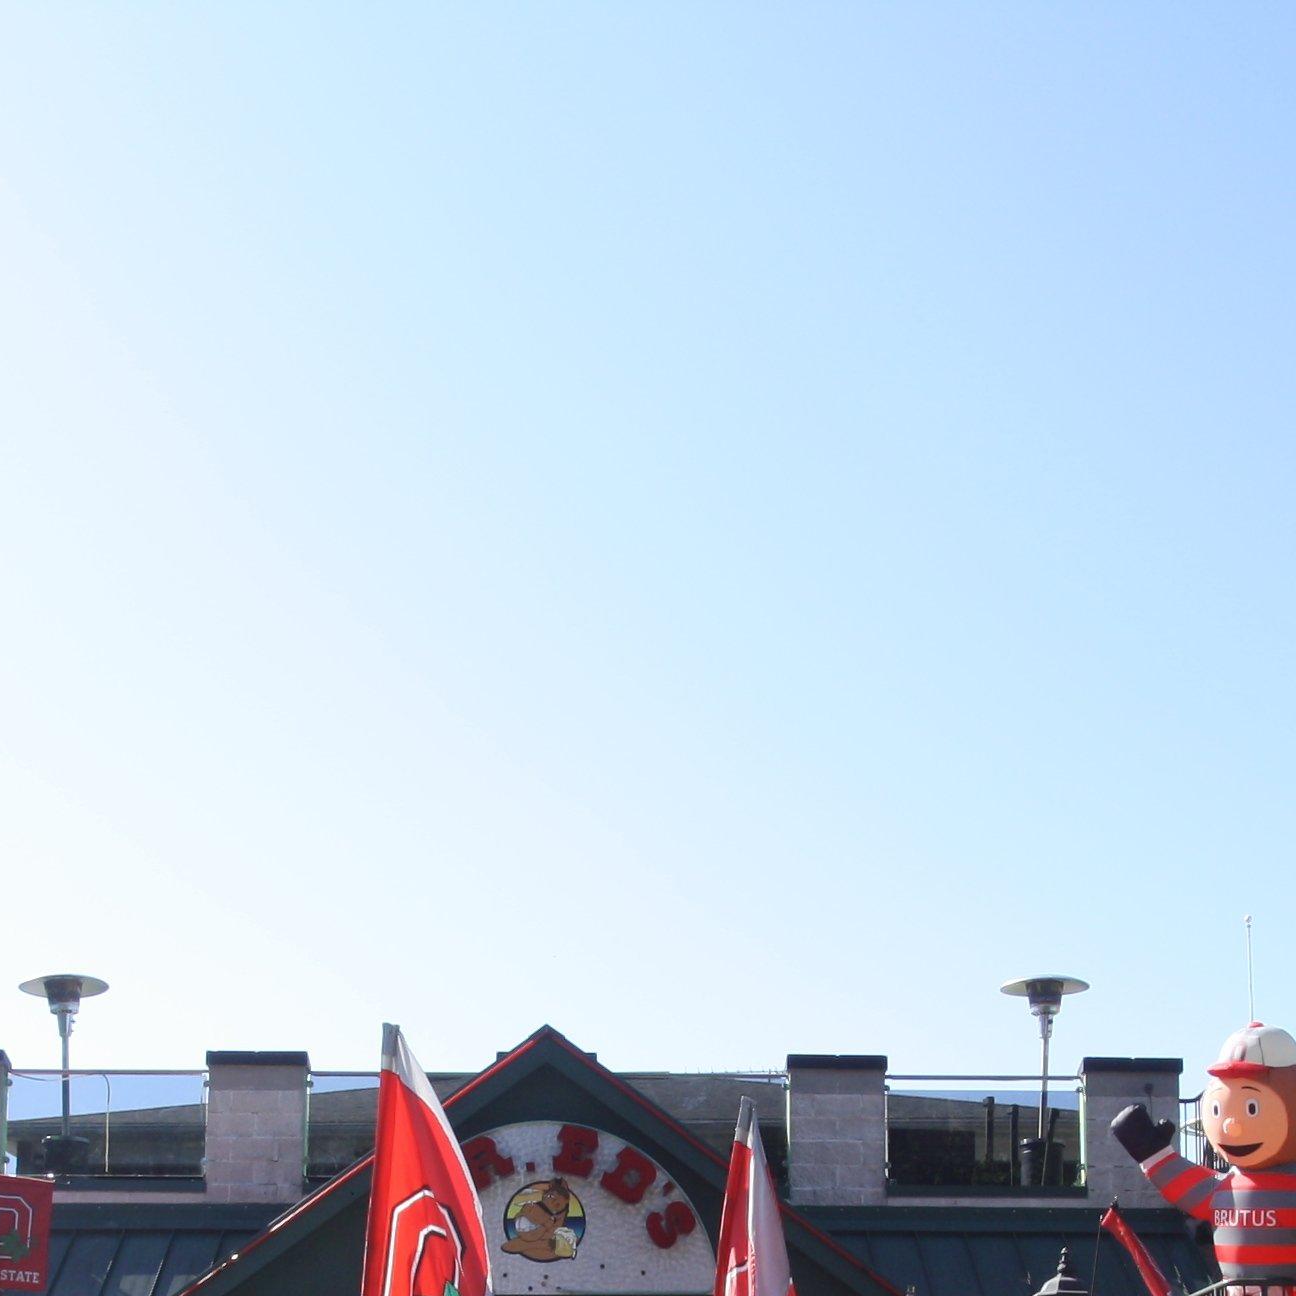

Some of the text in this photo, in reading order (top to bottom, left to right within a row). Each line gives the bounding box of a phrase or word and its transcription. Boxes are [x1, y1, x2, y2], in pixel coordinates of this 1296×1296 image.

[463, 1123, 696, 1249] R. ED'S
[1214, 1209, 1277, 1227] BRUTUS
[0, 1269, 40, 1284] STATE
